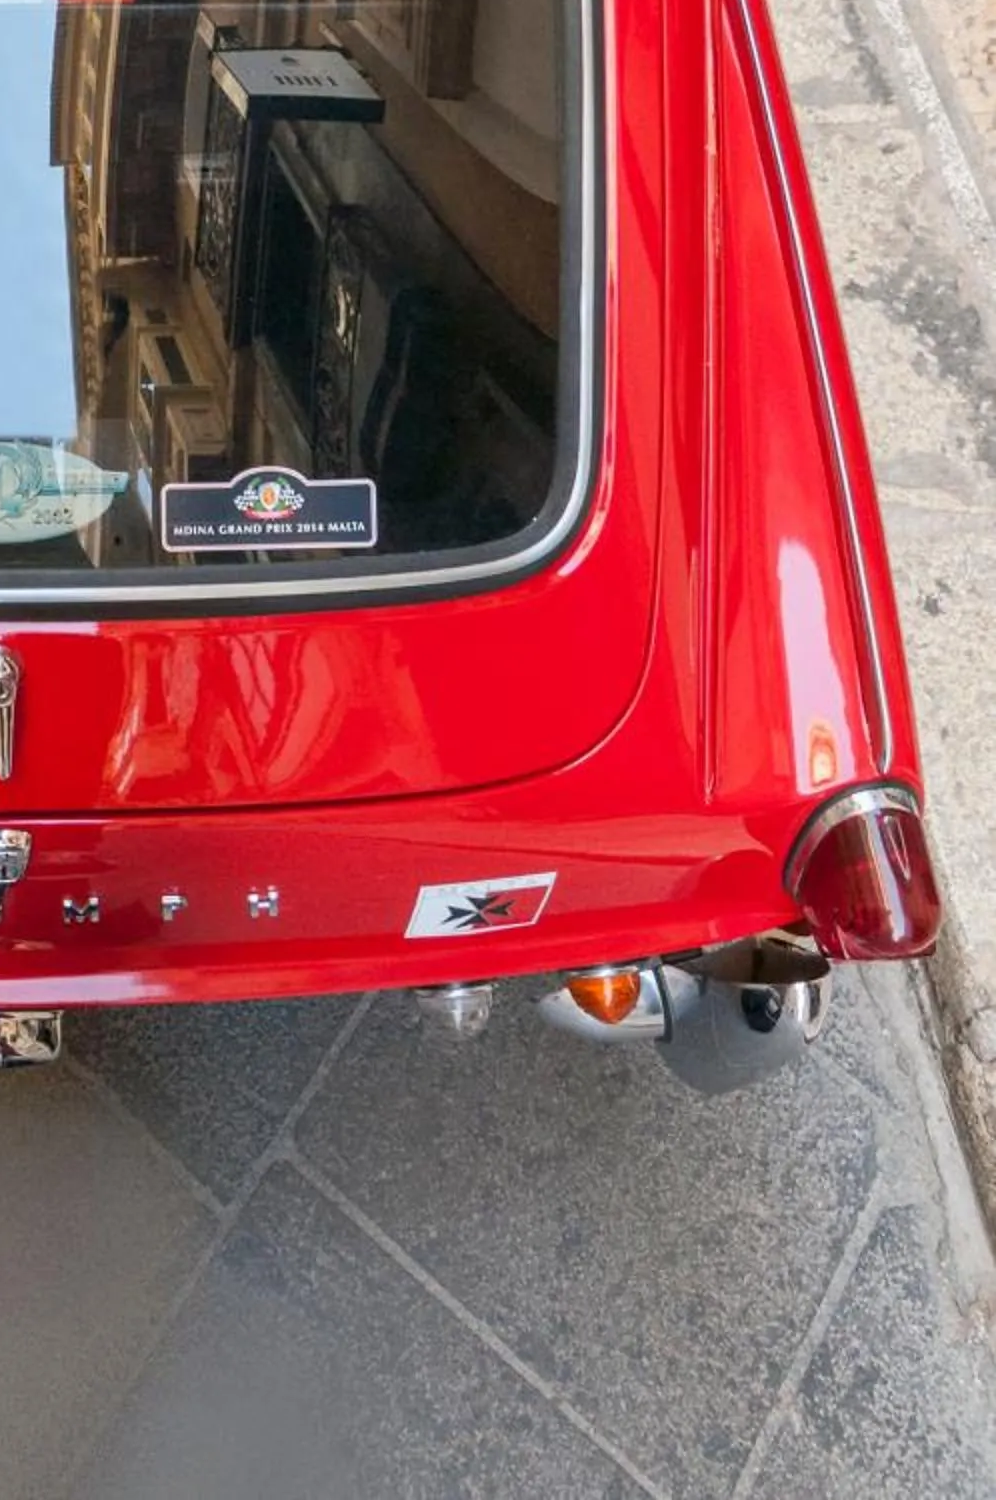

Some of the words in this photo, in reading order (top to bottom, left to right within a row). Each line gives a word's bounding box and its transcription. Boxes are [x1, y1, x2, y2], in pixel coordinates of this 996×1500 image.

[173, 523, 215, 536] MDINA
[218, 522, 262, 535] GRAND
[265, 522, 293, 534] PRIX
[327, 521, 366, 533] MALTA
